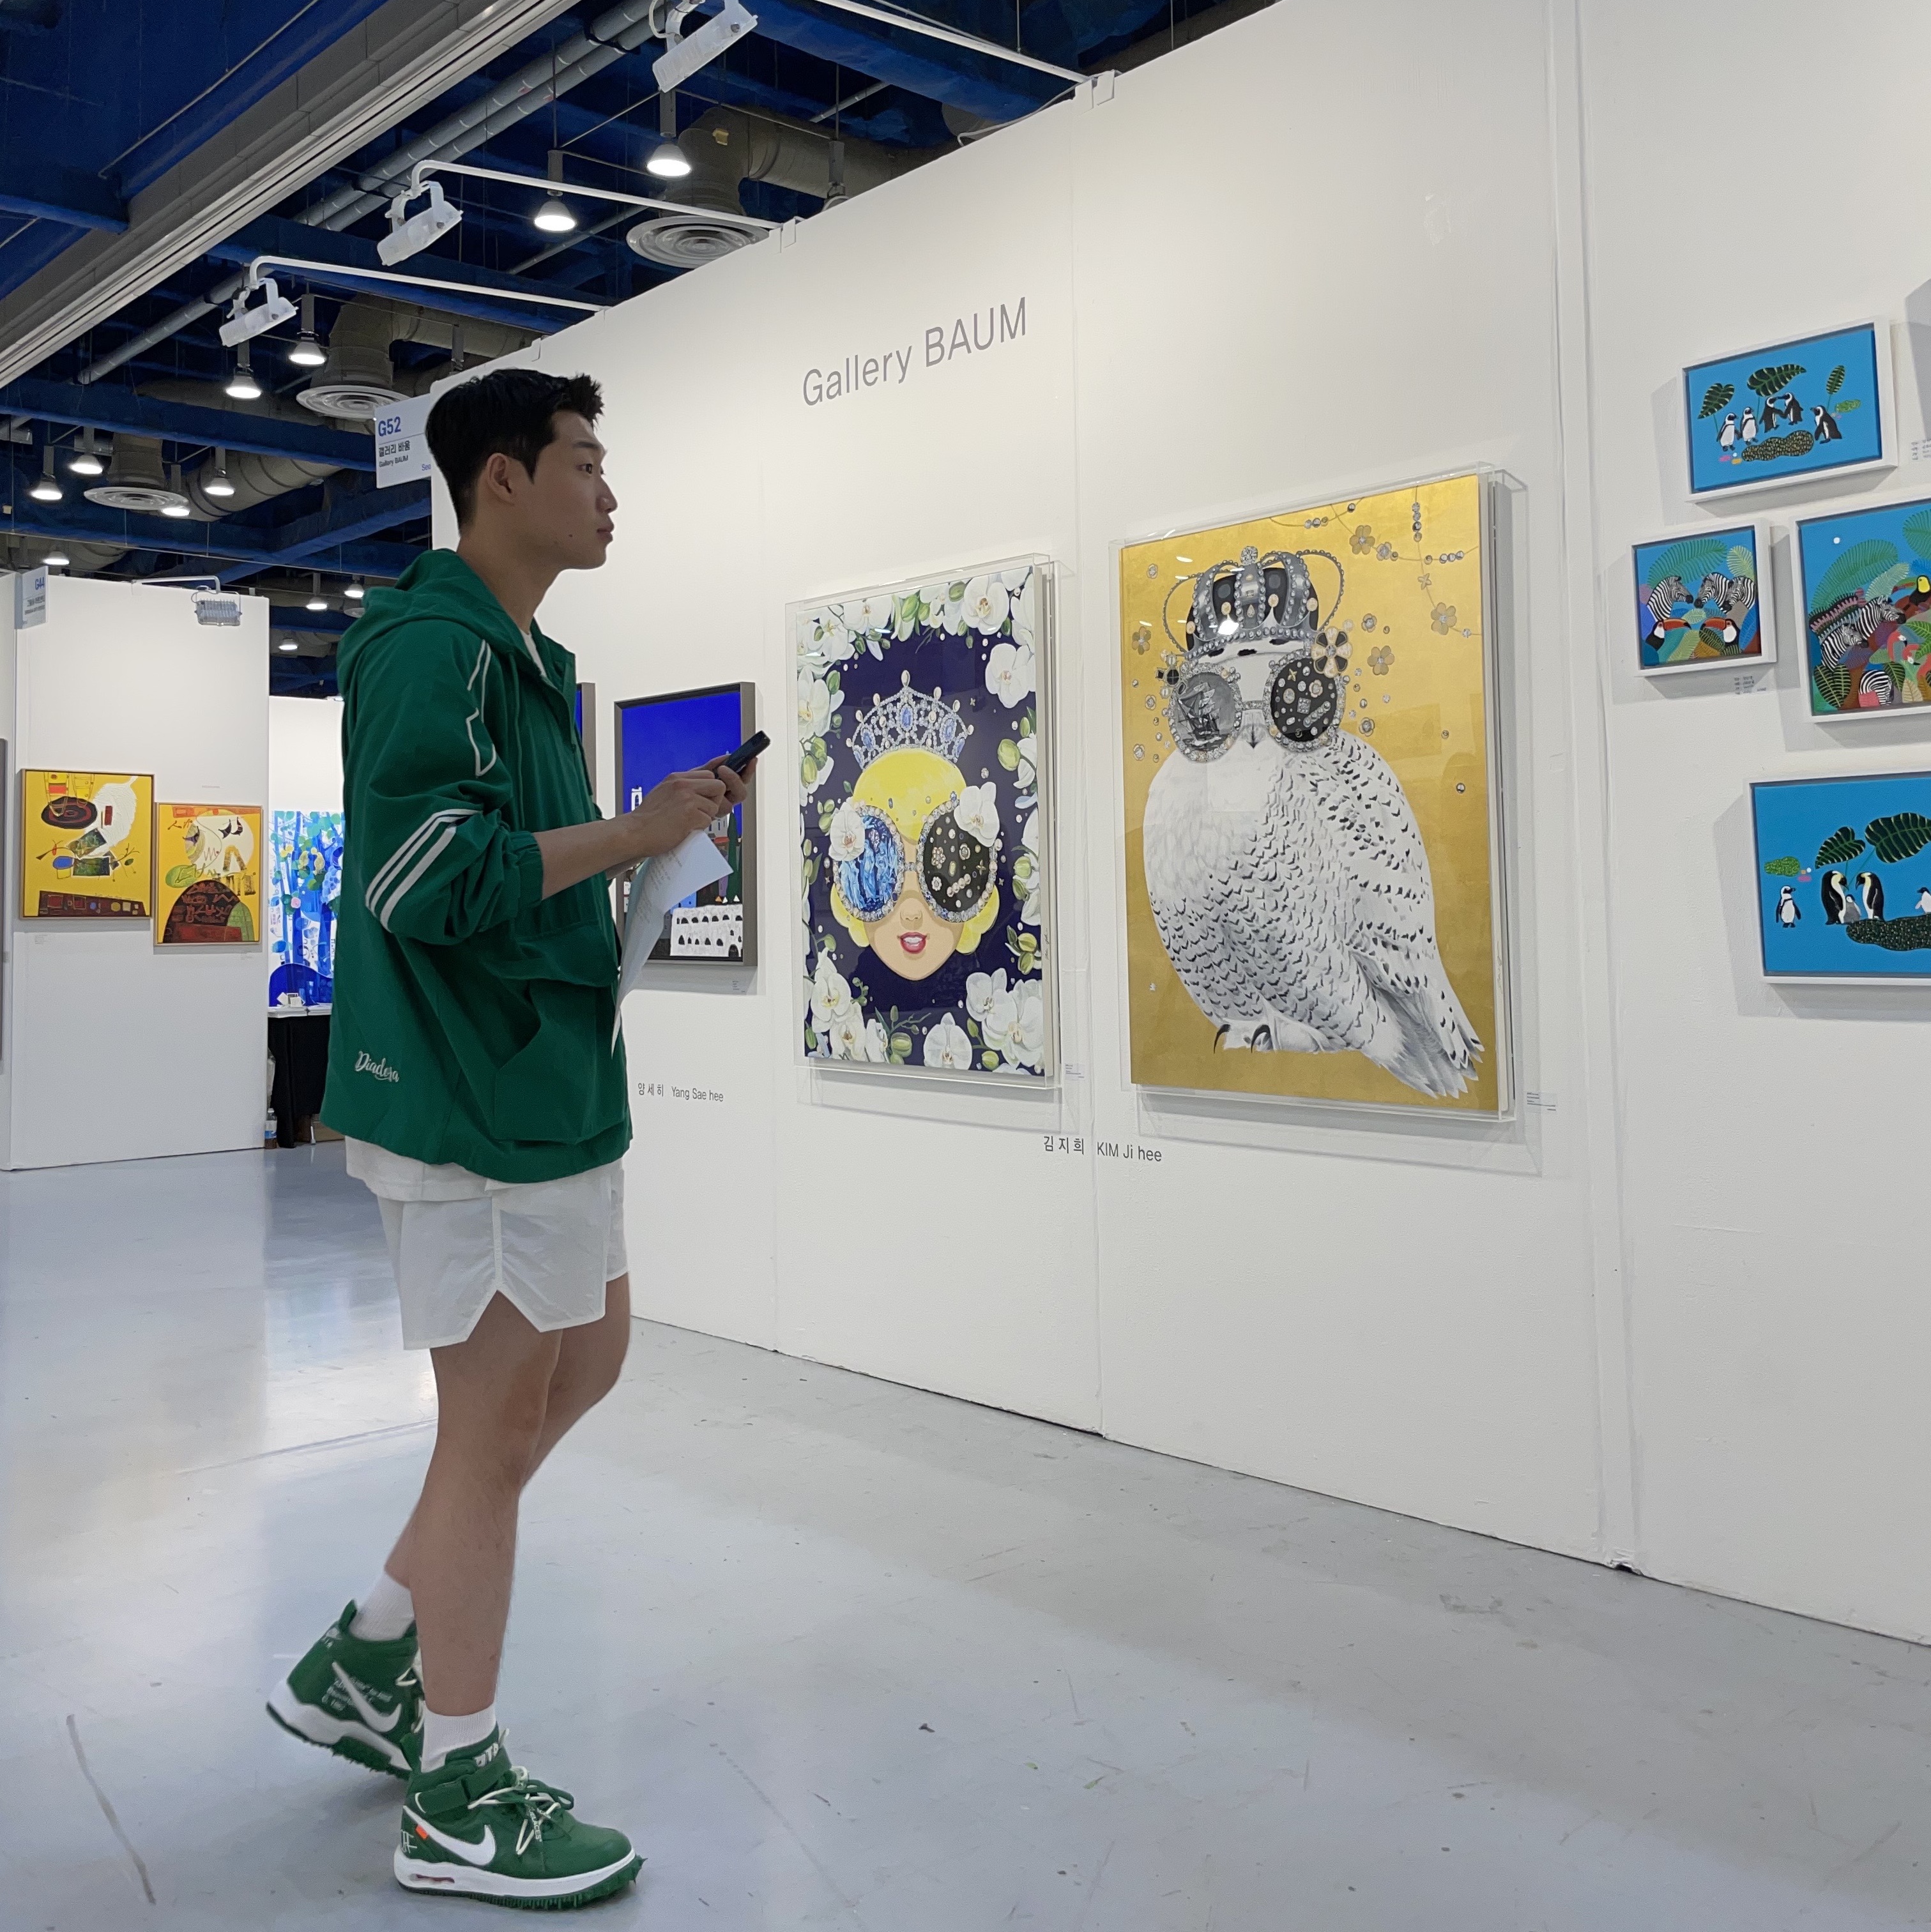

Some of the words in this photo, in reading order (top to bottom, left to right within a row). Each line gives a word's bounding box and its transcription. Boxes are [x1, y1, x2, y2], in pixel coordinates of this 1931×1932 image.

[803, 346, 913, 406] Gallery
[926, 296, 1025, 368] BAUM
[378, 416, 401, 437] G52
[355, 1051, 400, 1083] Diadora
[671, 1086, 690, 1100] Yang
[692, 1088, 707, 1100] Sae
[709, 1090, 724, 1102] hee
[1097, 1141, 1118, 1157] KIM
[1123, 1144, 1133, 1159] Ji
[1138, 1145, 1162, 1162] hee
